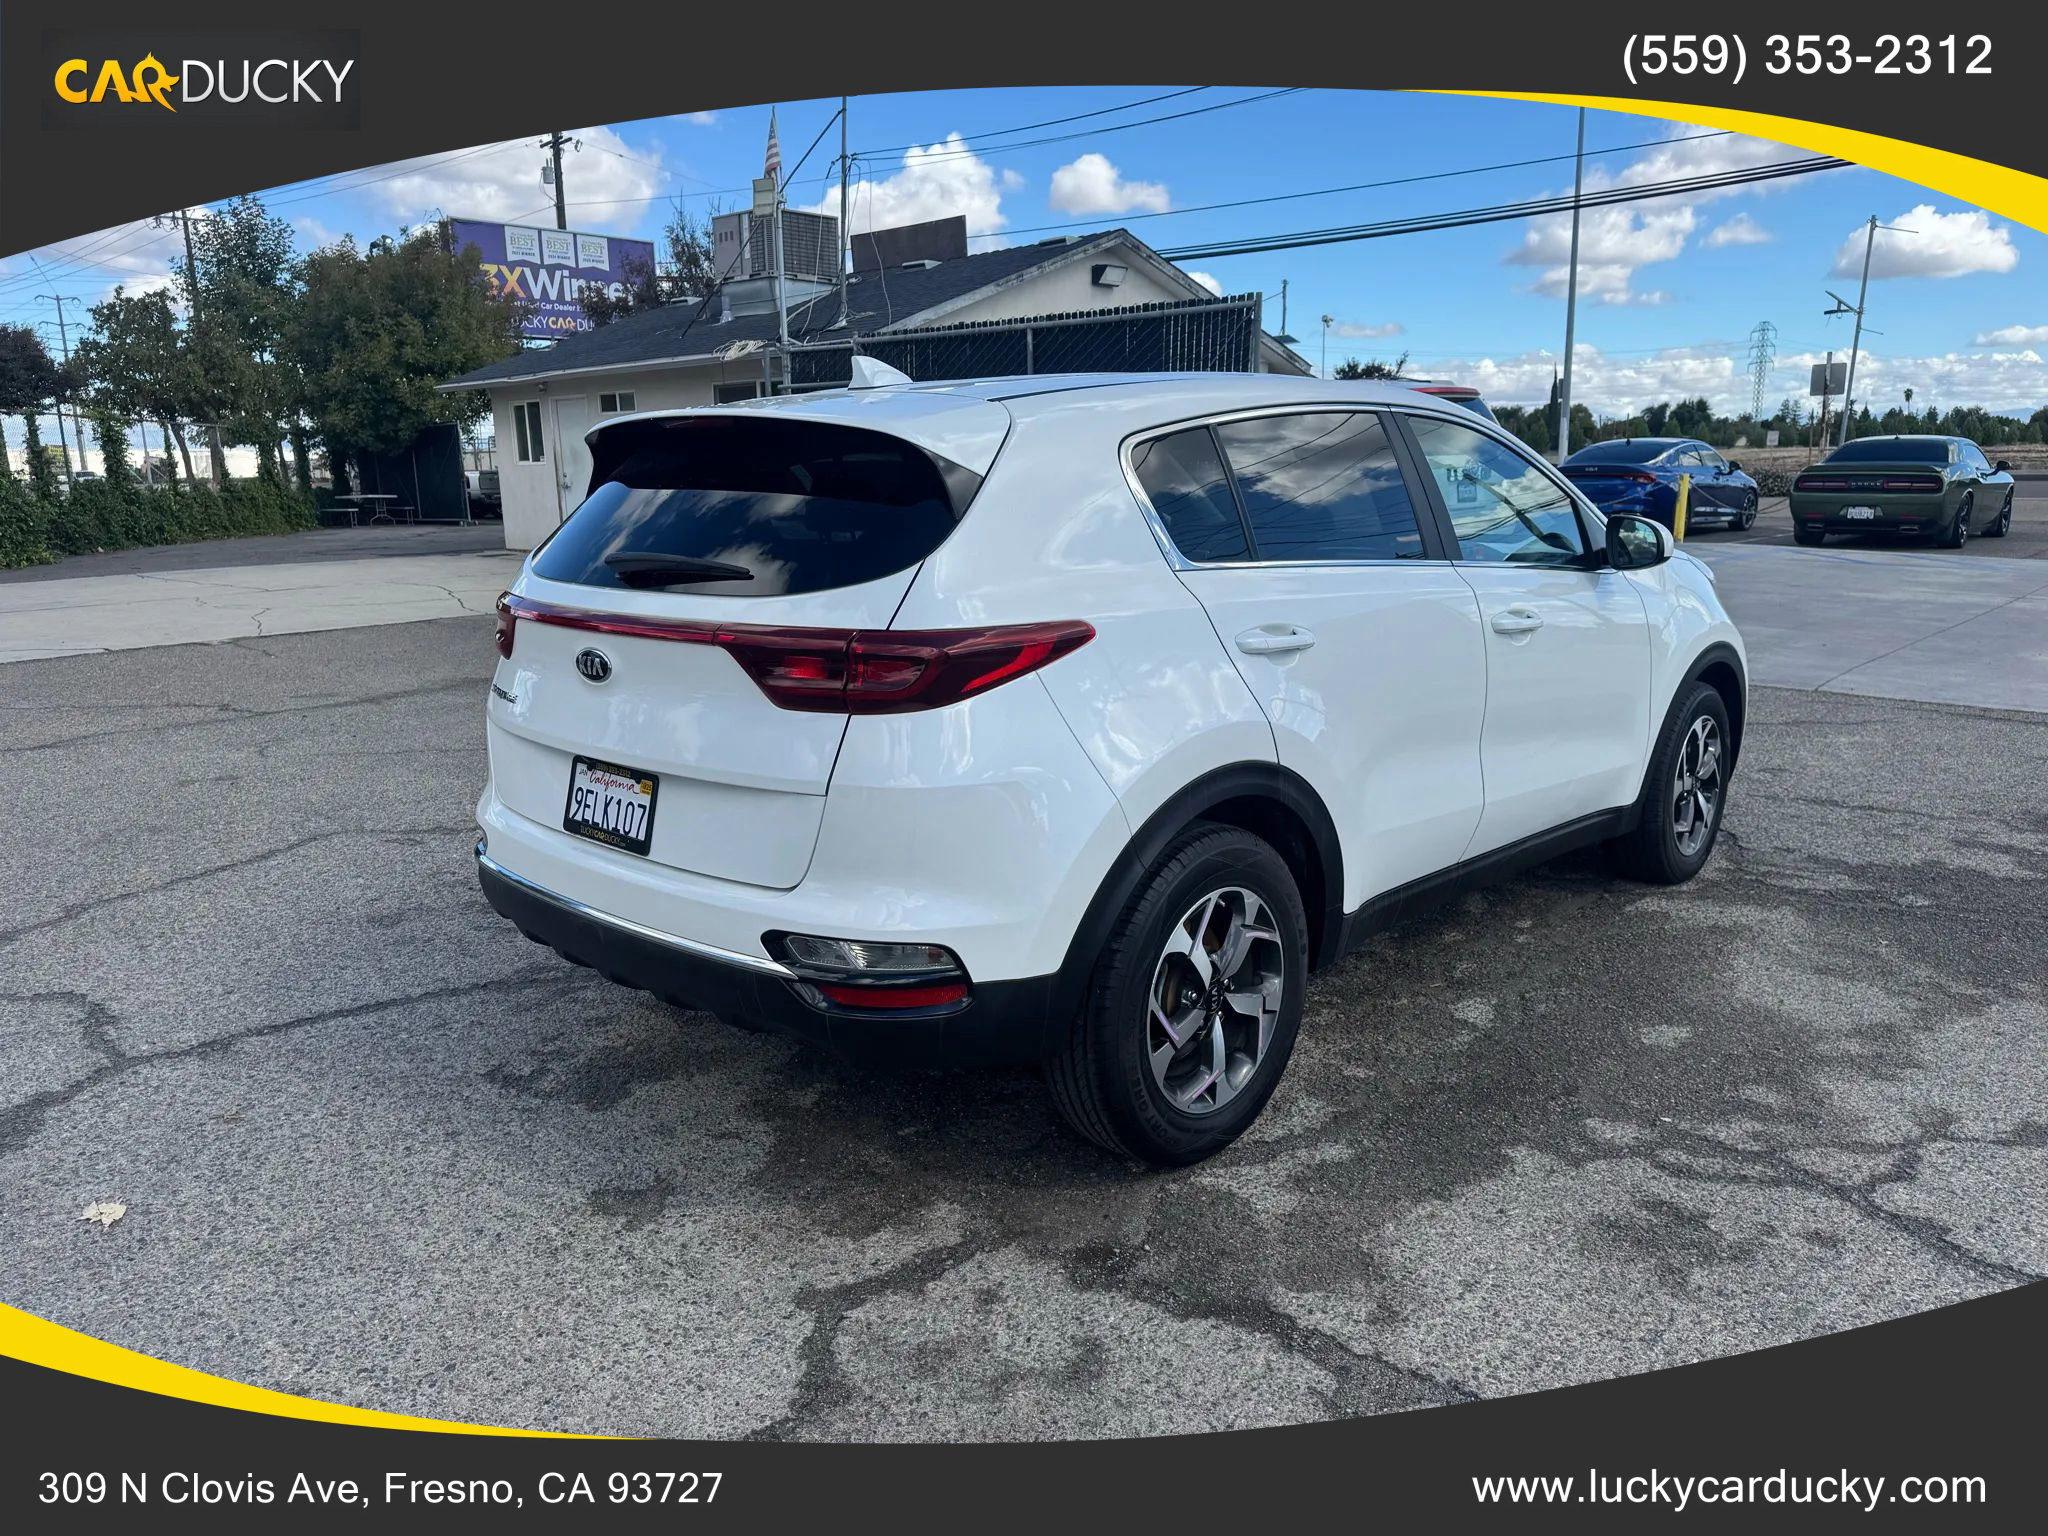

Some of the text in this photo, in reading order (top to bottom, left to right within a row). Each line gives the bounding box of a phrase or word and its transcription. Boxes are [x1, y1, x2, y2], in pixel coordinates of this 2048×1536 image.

[510, 236, 535, 247] BEST
[546, 239, 571, 251] BEST
[581, 243, 605, 255] BEST
[540, 302, 553, 310] Car
[554, 303, 576, 312] Dealer
[579, 655, 604, 676] KIA
[589, 768, 641, 794] California
[571, 786, 648, 839] 9ELK107
